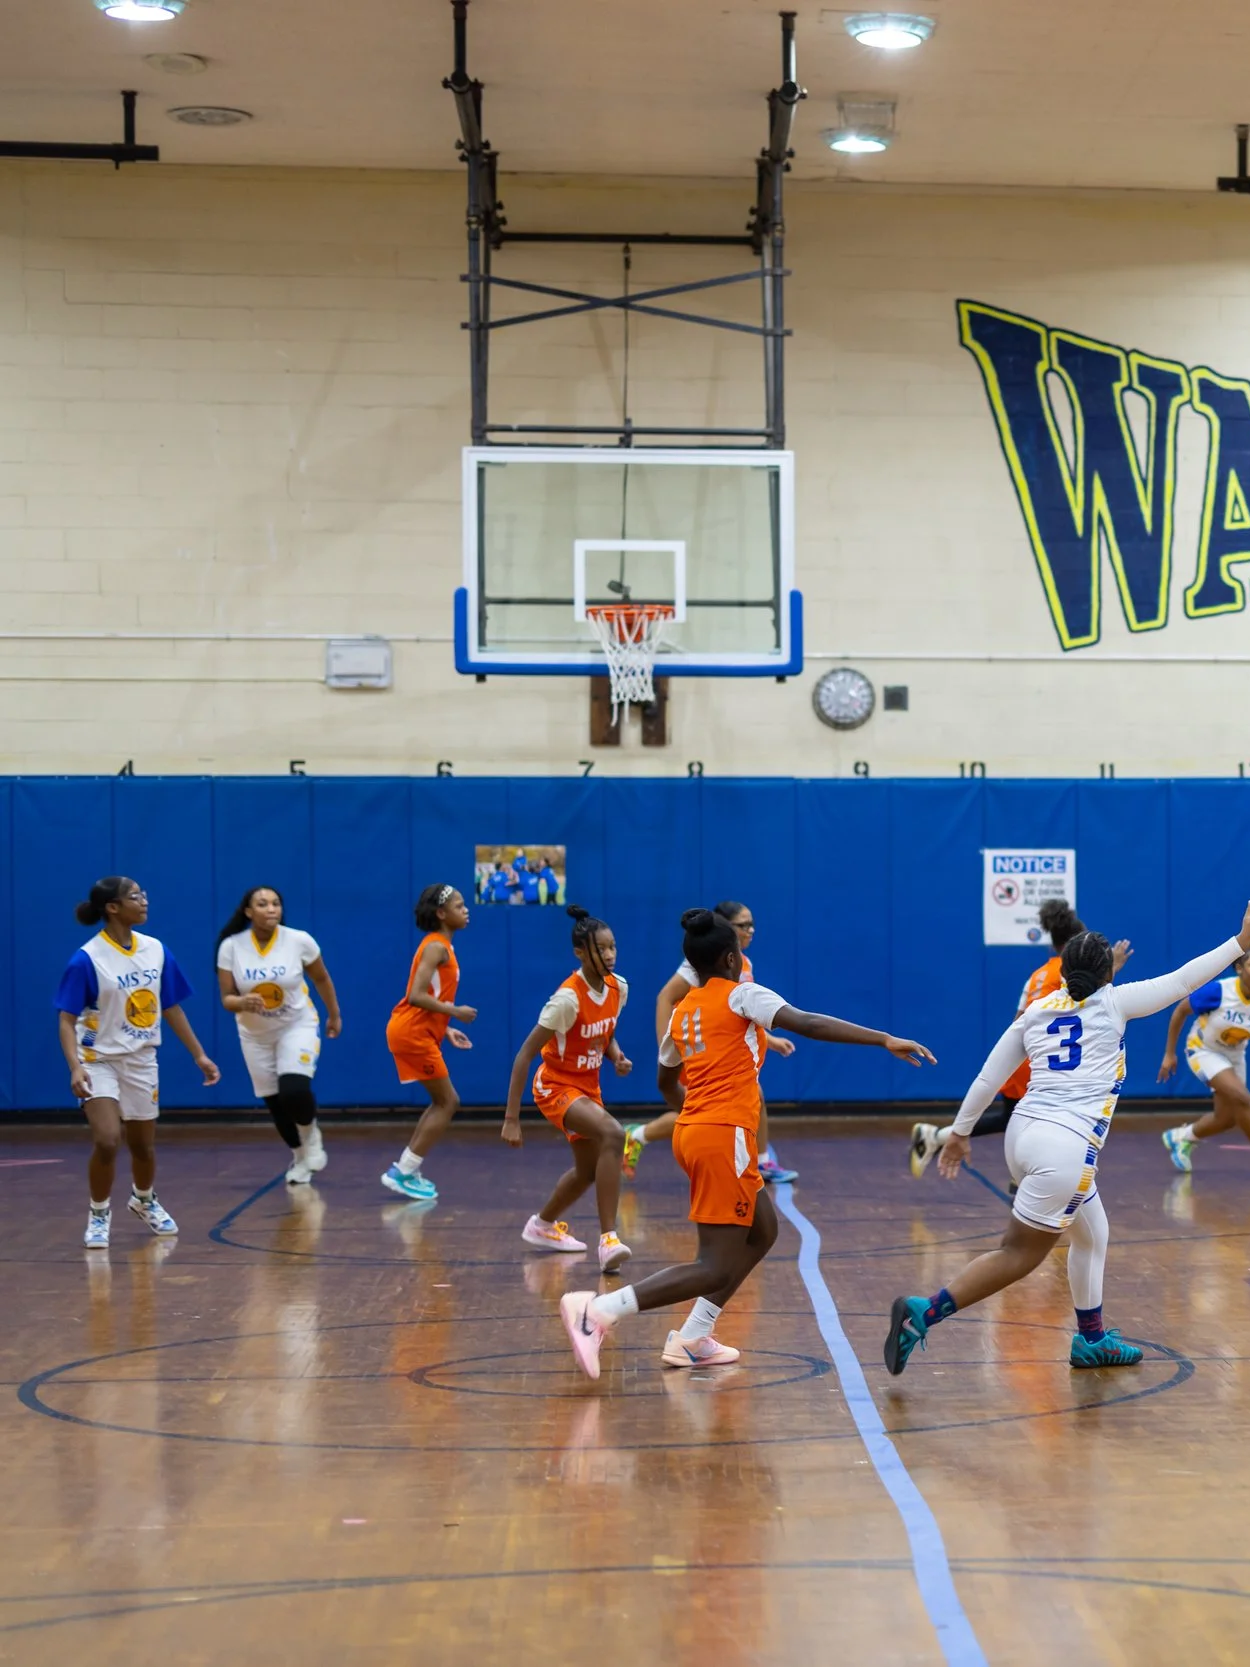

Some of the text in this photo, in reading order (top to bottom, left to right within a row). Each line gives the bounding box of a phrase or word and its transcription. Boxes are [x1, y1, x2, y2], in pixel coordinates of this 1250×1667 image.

[118, 760, 135, 777] 4
[289, 760, 306, 777] 5
[436, 761, 454, 778] 6
[578, 761, 595, 778] 7
[853, 761, 870, 779] 9
[958, 761, 987, 779] 10
[1099, 762, 1115, 779] 11
[995, 856, 1066, 873] NOTICE
[117, 968, 159, 990] MS 50
[244, 966, 287, 981] MS 50
[1223, 1009, 1246, 1025] MS
[580, 1016, 617, 1039] UNITY
[681, 1007, 706, 1057] 11
[1046, 1015, 1083, 1071] 3
